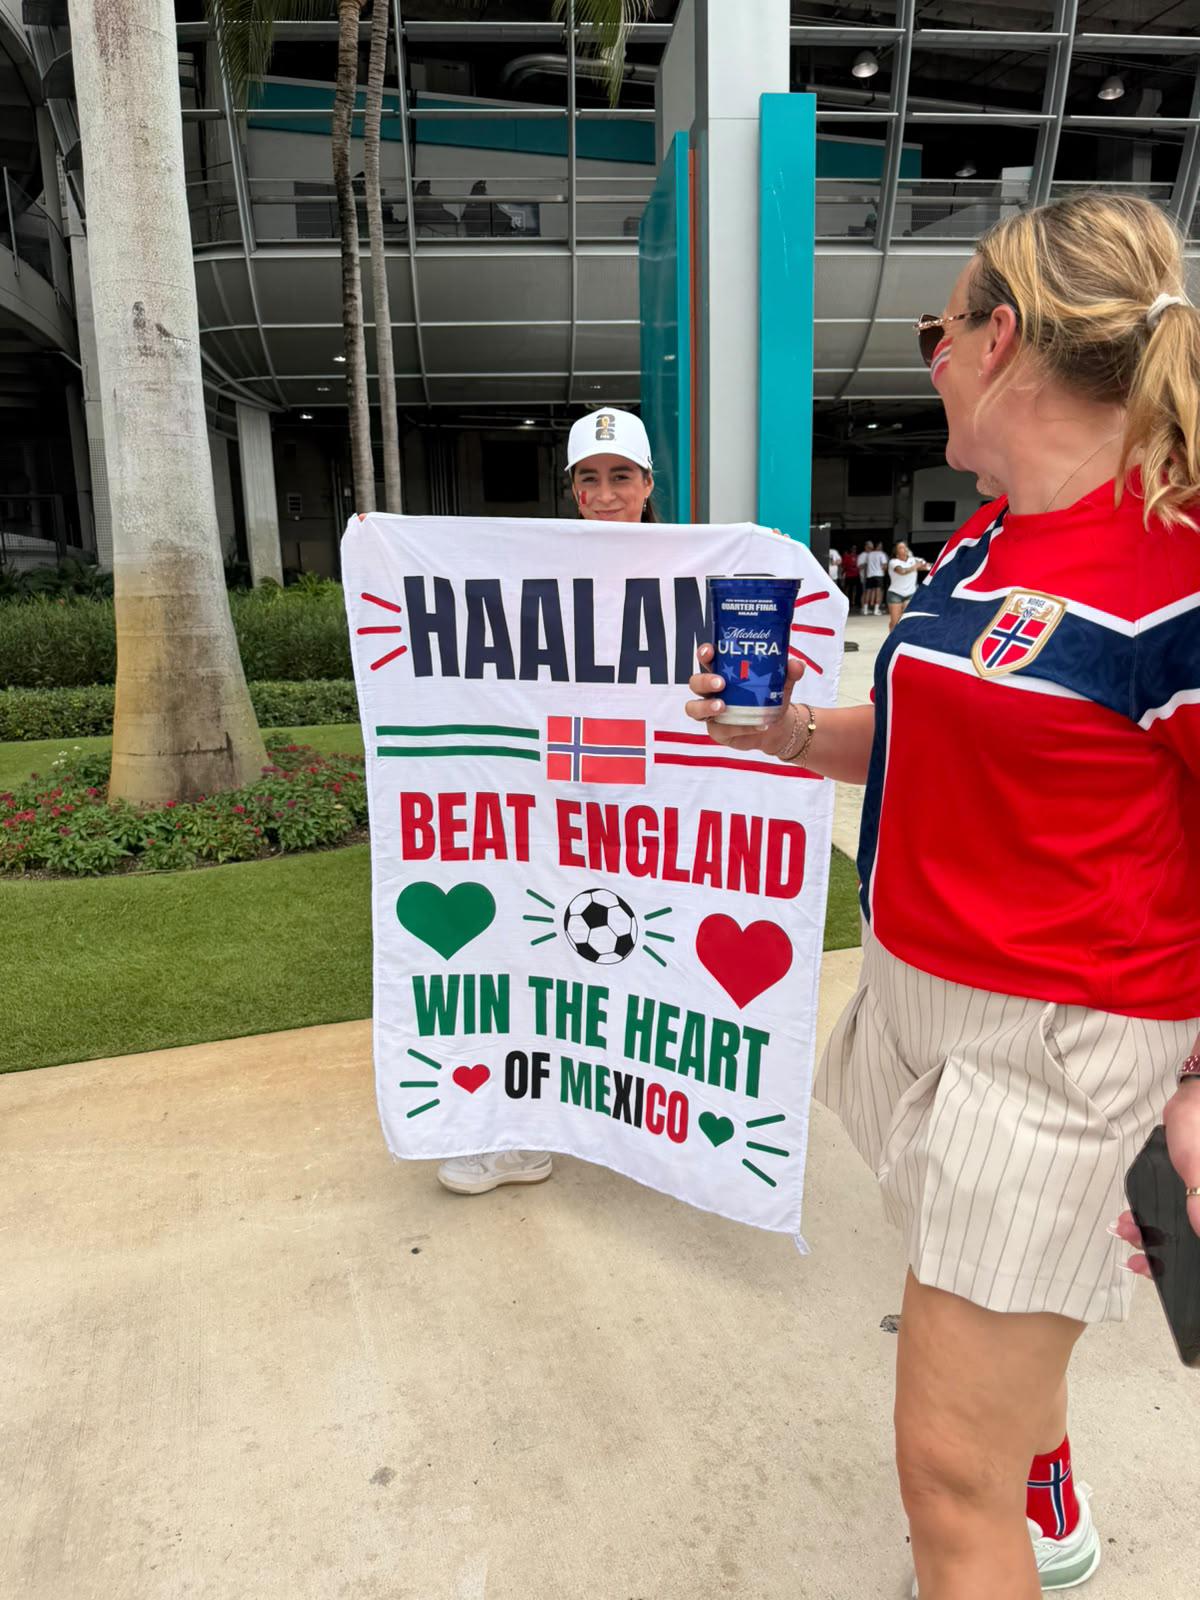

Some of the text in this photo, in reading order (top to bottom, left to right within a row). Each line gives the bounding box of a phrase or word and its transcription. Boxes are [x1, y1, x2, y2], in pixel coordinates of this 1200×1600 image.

[403, 573, 777, 685] HAALAN
[718, 641, 782, 656] ULTRA
[721, 603, 754, 611] QUARTER
[400, 792, 806, 899] BEAT ENGLAND
[412, 974, 770, 1099] WIN THE HEART
[505, 1050, 689, 1144] OF MEXICO
